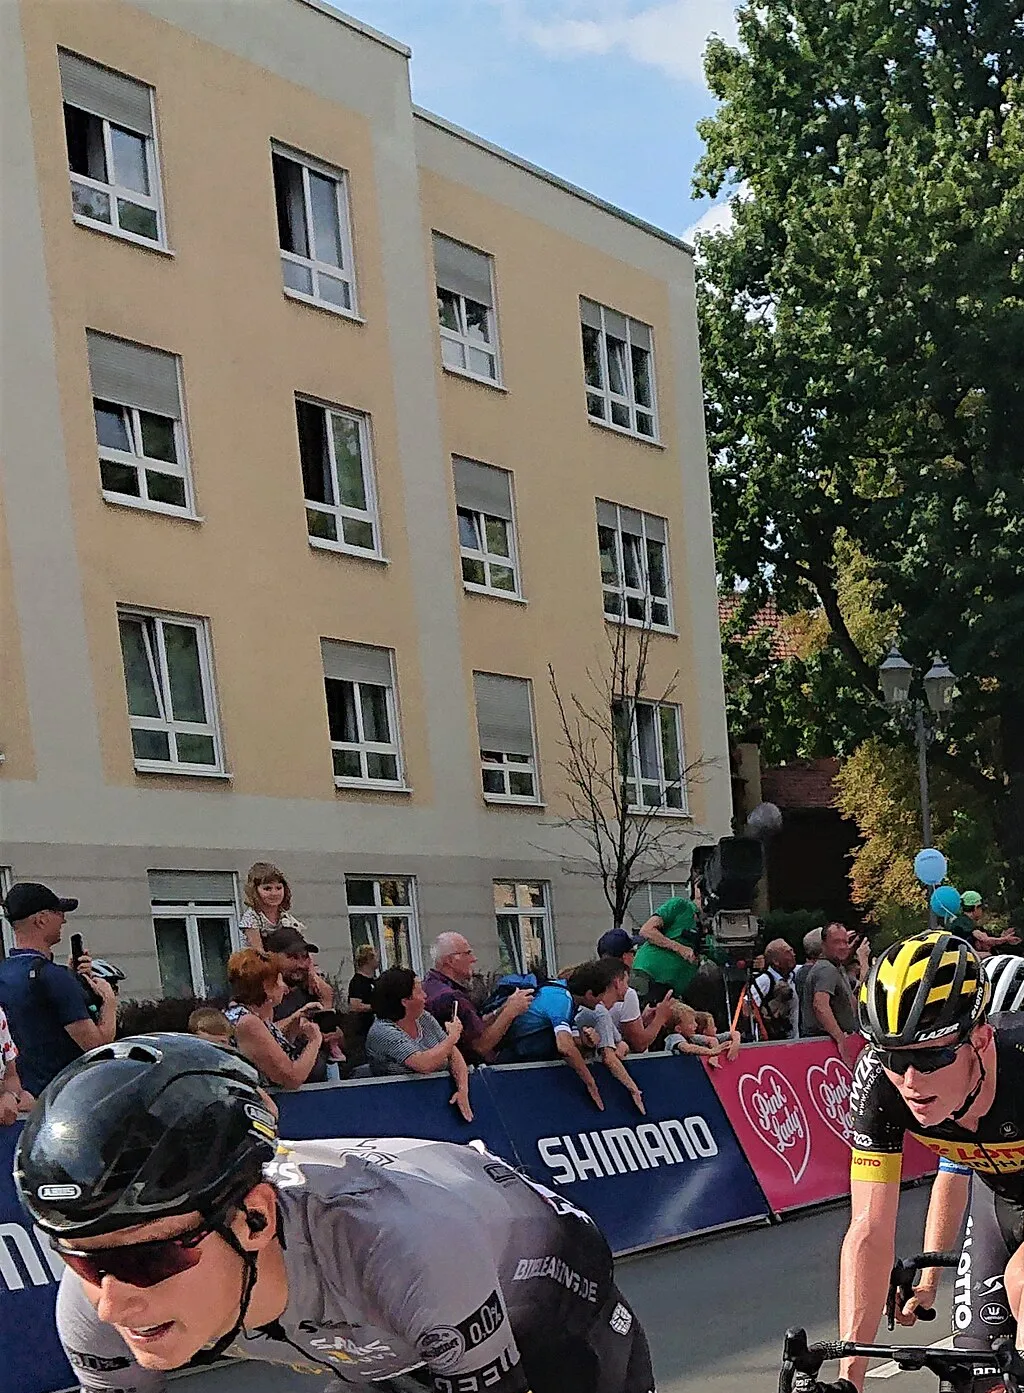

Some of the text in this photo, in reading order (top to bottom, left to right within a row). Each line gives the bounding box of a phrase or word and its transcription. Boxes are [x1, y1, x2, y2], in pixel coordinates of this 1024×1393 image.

[918, 1022, 960, 1042] LAZER
[752, 1075, 787, 1131] Pink
[819, 1067, 851, 1119] Pink
[537, 1115, 719, 1185] SHIMANO
[769, 1105, 804, 1152] Lady
[853, 1157, 881, 1167] LOTTO
